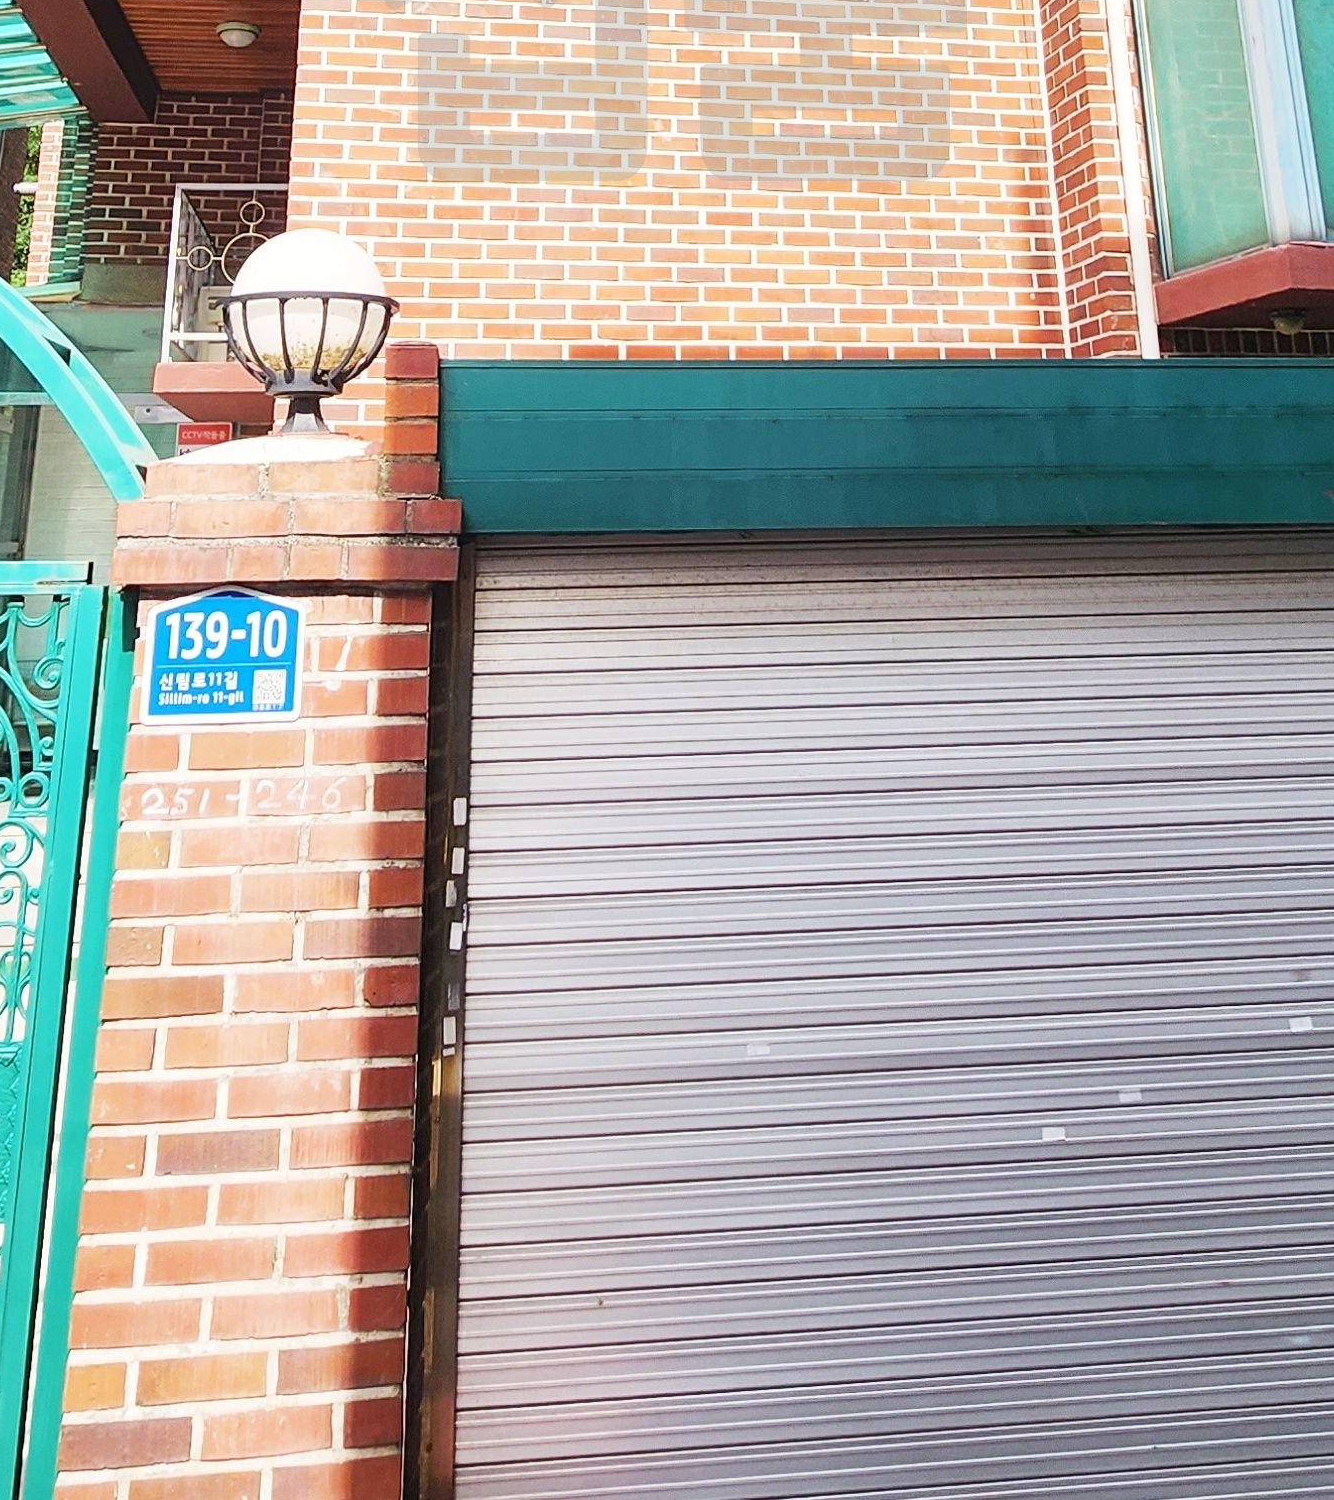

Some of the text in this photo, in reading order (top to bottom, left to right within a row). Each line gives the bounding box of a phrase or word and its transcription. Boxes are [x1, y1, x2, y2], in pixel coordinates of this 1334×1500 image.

[165, 609, 288, 661] 139-10
[158, 670, 238, 692] 신림로11길
[158, 690, 244, 706] Sillim-ro 11-gil
